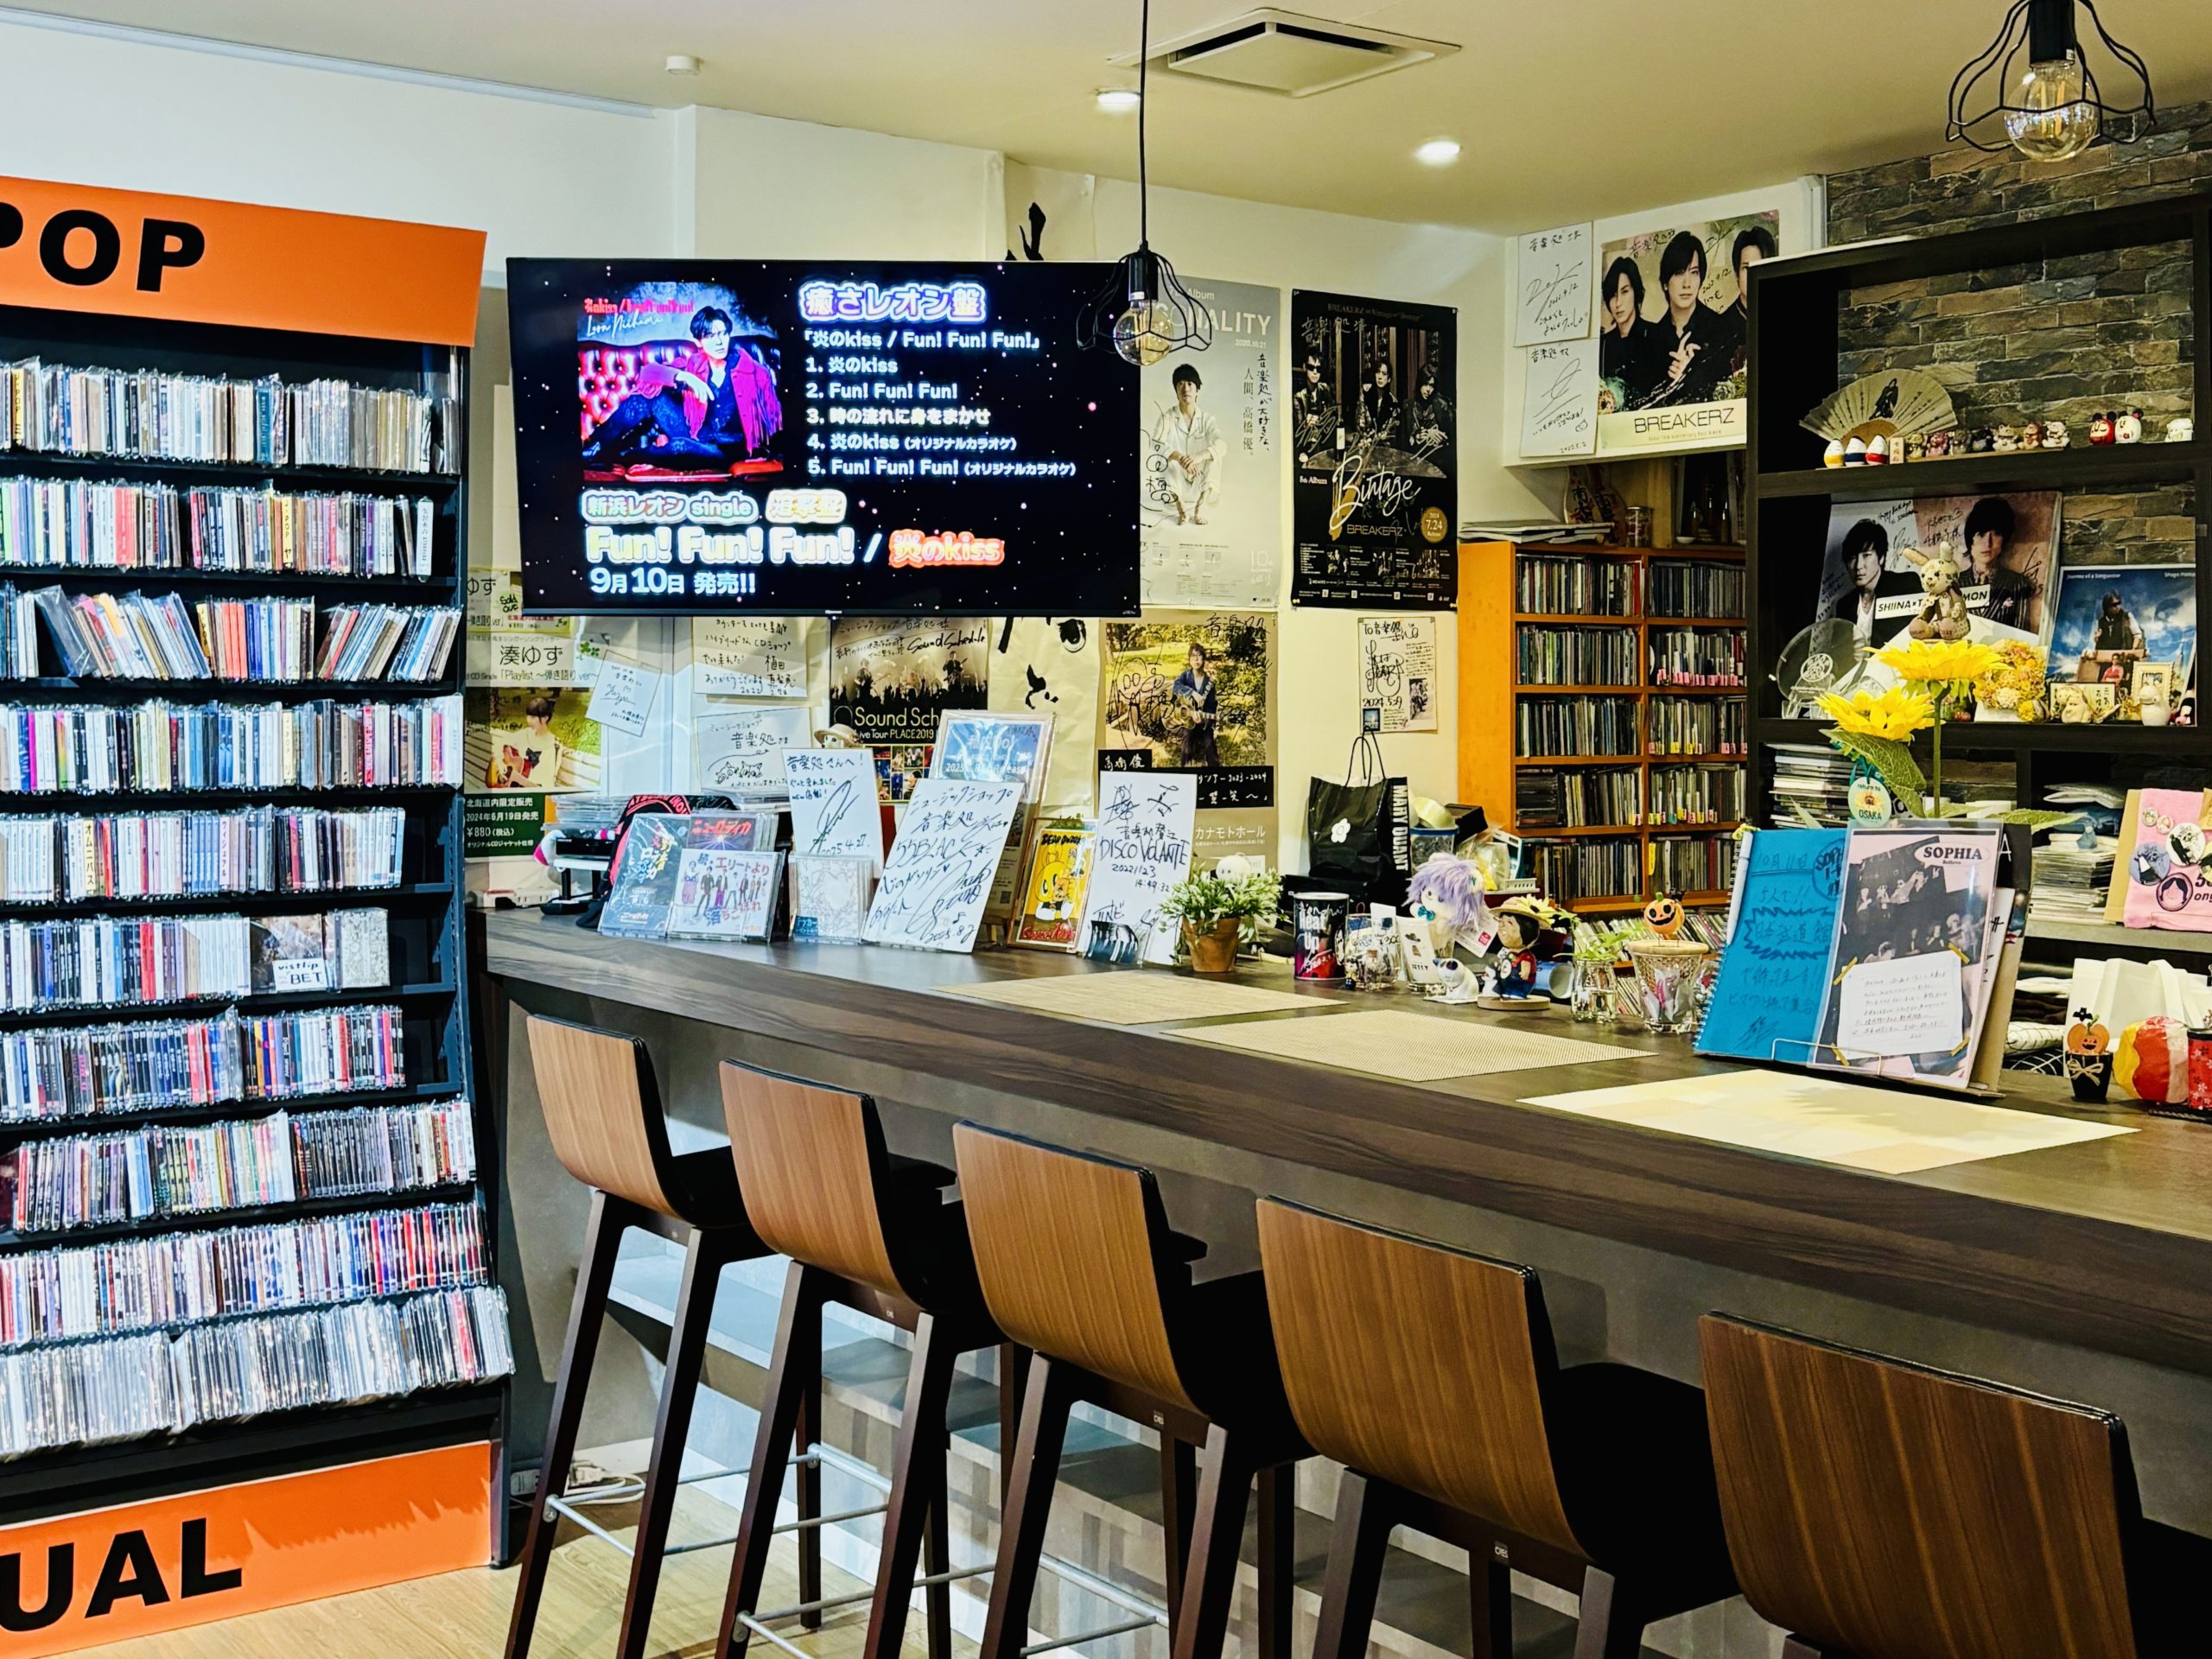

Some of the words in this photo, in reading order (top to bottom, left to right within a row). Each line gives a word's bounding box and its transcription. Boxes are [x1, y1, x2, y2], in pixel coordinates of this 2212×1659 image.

[803, 283, 984, 321] 癒さレオン盤
[903, 332, 942, 347] Fun!
[948, 332, 987, 347] Fun!
[805, 357, 823, 372] 1.
[828, 356, 899, 373] 炎のkiss
[805, 383, 823, 399] 2.
[830, 383, 868, 399] Fun!
[874, 383, 913, 399] Fun!
[918, 383, 957, 399] Fun!
[806, 409, 824, 424] 3.
[830, 406, 991, 425] 時の流れに身をまかせ
[1634, 408, 1734, 433] BREAKERZ
[807, 434, 825, 450] 4.
[830, 433, 899, 450] 炎のkiss
[808, 459, 826, 475] 5.
[831, 459, 870, 475] Fun!
[875, 459, 915, 475] Fun!
[920, 459, 959, 475] Fun!
[1329, 451, 1421, 531] Bintage
[585, 493, 687, 519] 新浜レオン
[690, 493, 754, 520] single
[1347, 524, 1403, 537] BREAKERZ
[1426, 520, 1443, 531] 7.24
[586, 526, 672, 563] Fun!
[679, 526, 763, 564] Fun!
[770, 526, 855, 564] Fun!
[891, 531, 1003, 565] 炎のkiss
[591, 567, 685, 594] 9月10日
[694, 571, 756, 594] 発売!!
[500, 645, 563, 665] 湊ゆず
[855, 706, 906, 726] Sound
[911, 707, 939, 726] Sch
[855, 729, 870, 738] ive
[872, 729, 888, 738] Tour
[890, 728, 933, 739] PLACE2019
[467, 798, 533, 807] 北海道内限定販売
[1392, 785, 1408, 823] MARY
[467, 811, 539, 821] 2024年6月19日発売
[1859, 810, 1882, 821] OSAKA
[1196, 825, 1265, 840] カナモトホール
[85, 823, 95, 886] オムニバス
[1100, 836, 1138, 861] DISCO
[1392, 827, 1408, 870] QUANT
[1923, 847, 1982, 861] SOPHIA
[1304, 931, 1320, 954] Up
[289, 972, 323, 985] BET
[0, 1518, 242, 1632] UAL
